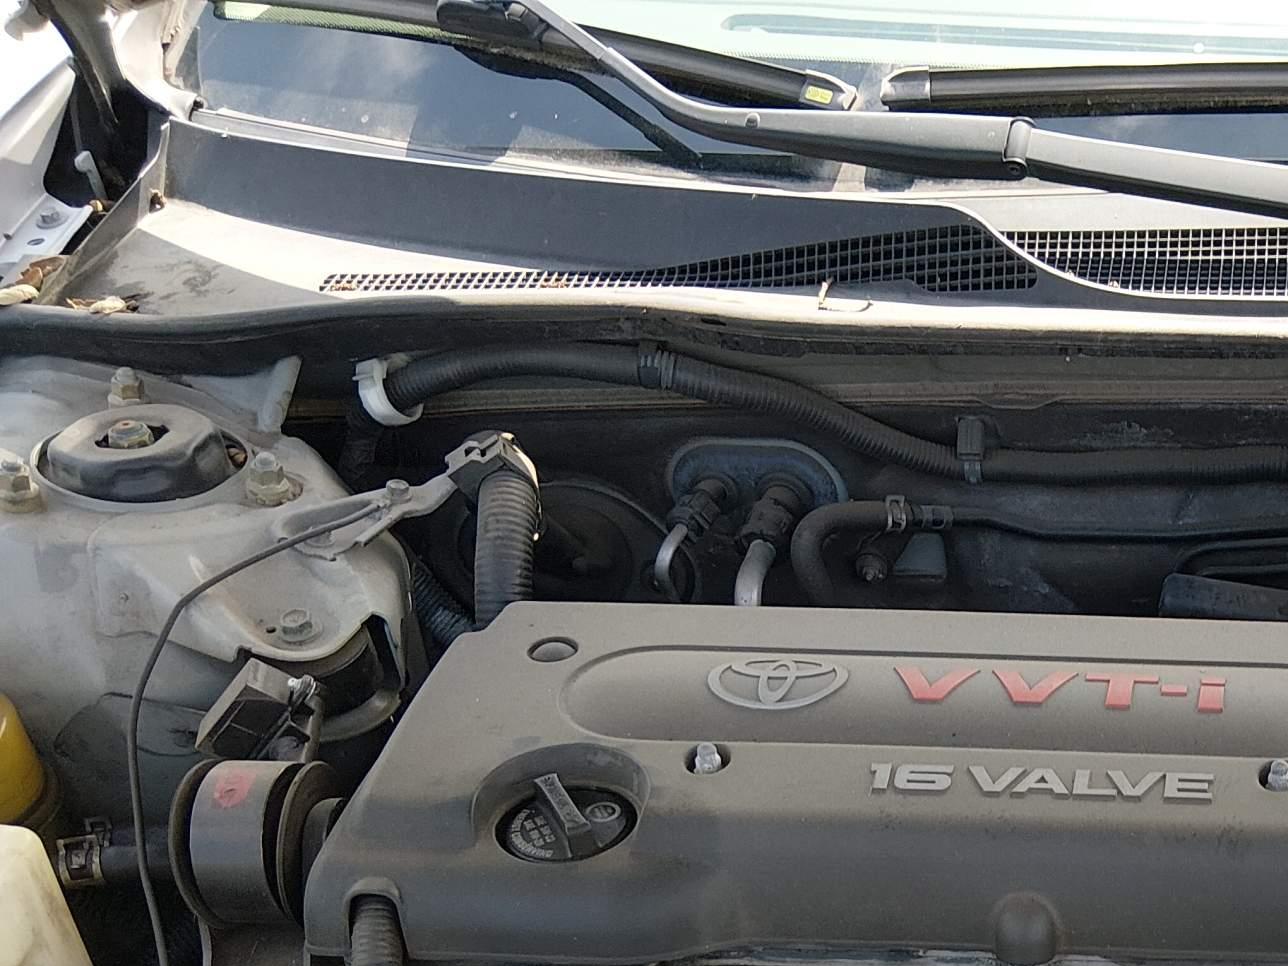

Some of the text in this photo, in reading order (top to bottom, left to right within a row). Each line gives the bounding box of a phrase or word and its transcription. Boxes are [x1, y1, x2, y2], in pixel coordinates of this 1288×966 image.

[893, 666, 1227, 713] VVT-i
[869, 762, 1216, 803] 16 VALVE
